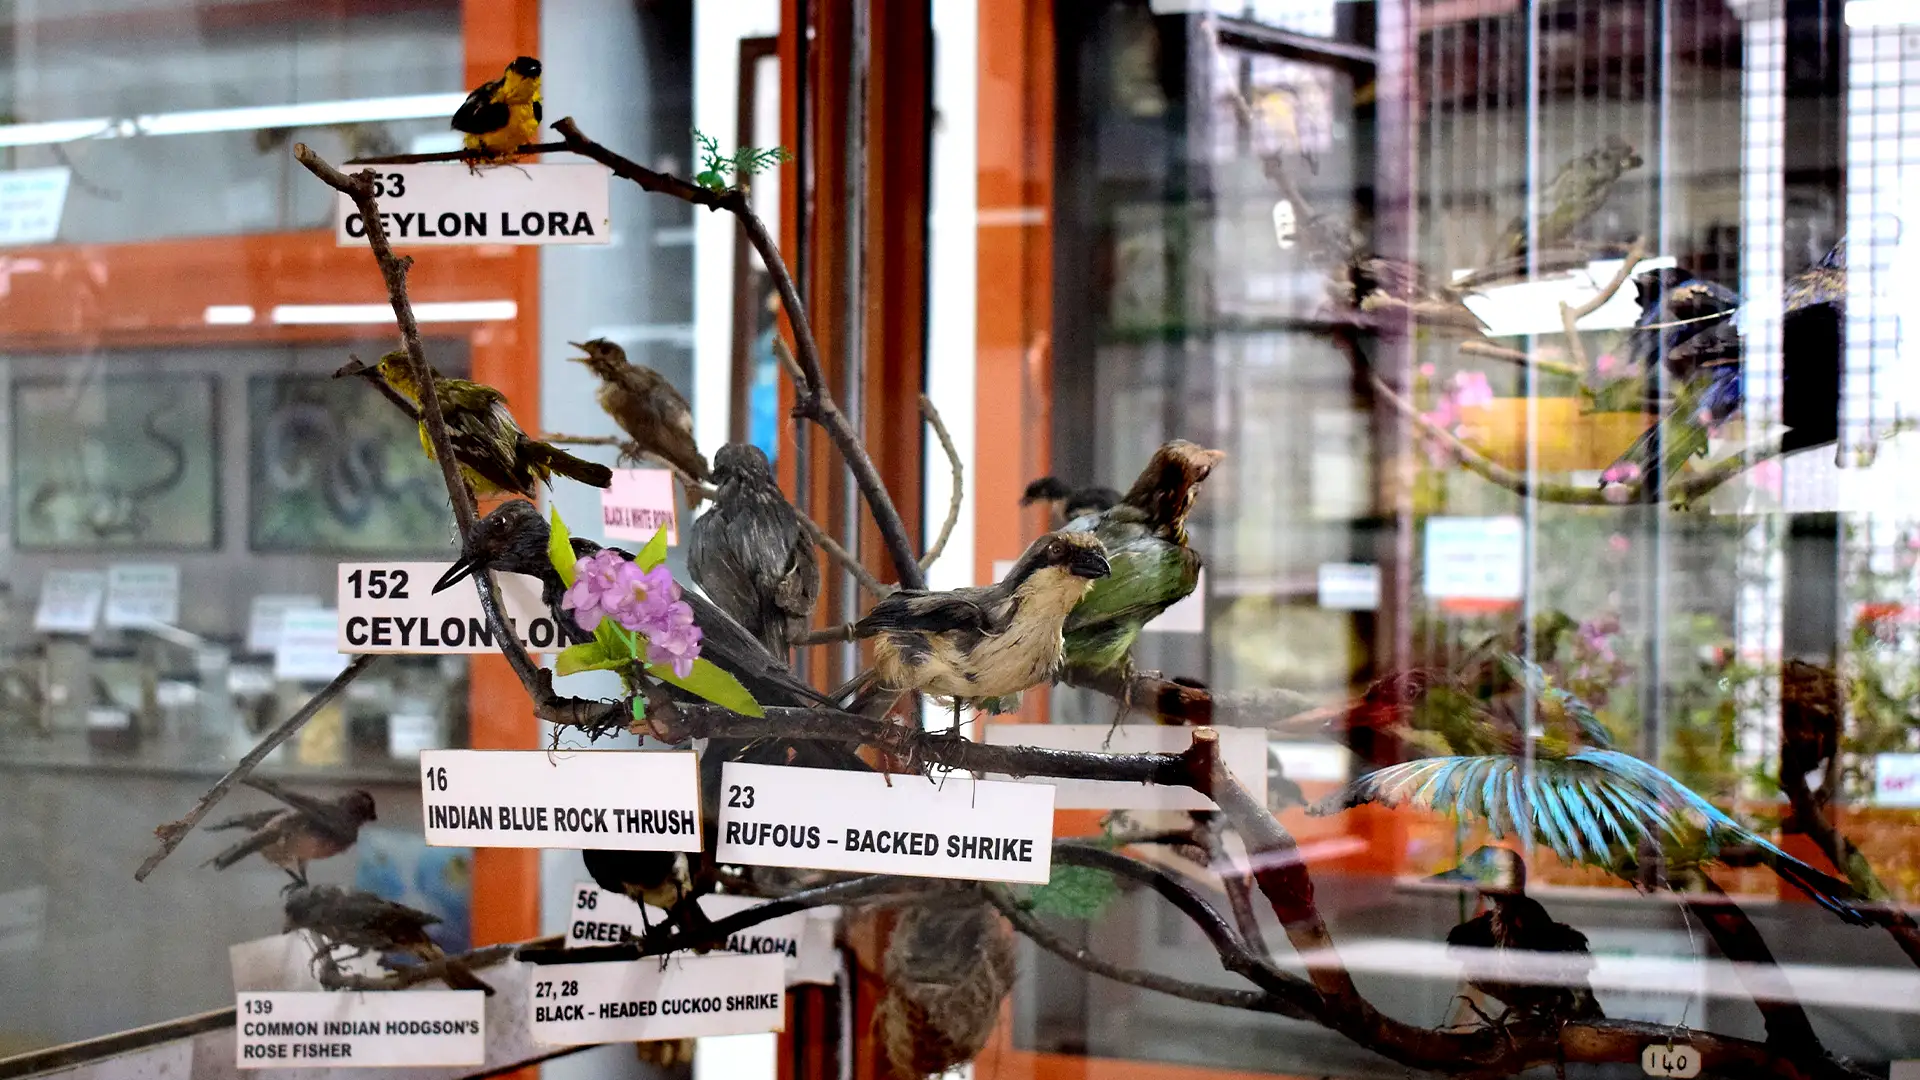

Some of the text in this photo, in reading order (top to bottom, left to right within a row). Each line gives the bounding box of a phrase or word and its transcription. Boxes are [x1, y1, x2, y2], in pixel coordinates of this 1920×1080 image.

[371, 173, 406, 198] 53
[501, 211, 595, 237] LORA
[347, 569, 409, 600] 152
[345, 616, 493, 648] CEYLON
[426, 766, 448, 792] 16
[727, 784, 755, 809] 23
[428, 805, 696, 835] INDIAN BLUE ROCK THRUSH
[725, 821, 821, 850] RUFOUS
[844, 828, 940, 857] BACKED
[946, 834, 1034, 863] SHRIKE
[577, 889, 598, 910] 56
[727, 935, 797, 958] ALKOHA
[535, 980, 579, 1001] 27, 28
[244, 999, 273, 1015] 139
[535, 1004, 585, 1023] BLACK
[599, 1000, 658, 1019] HEADED
[661, 996, 723, 1016] CUCKOO
[726, 993, 780, 1012] SHRIKE
[244, 1021, 319, 1037] COMMON
[323, 1021, 381, 1036] INDIAN
[243, 1043, 353, 1059] ROSE FISHER
[1651, 1051, 1688, 1074] 140
